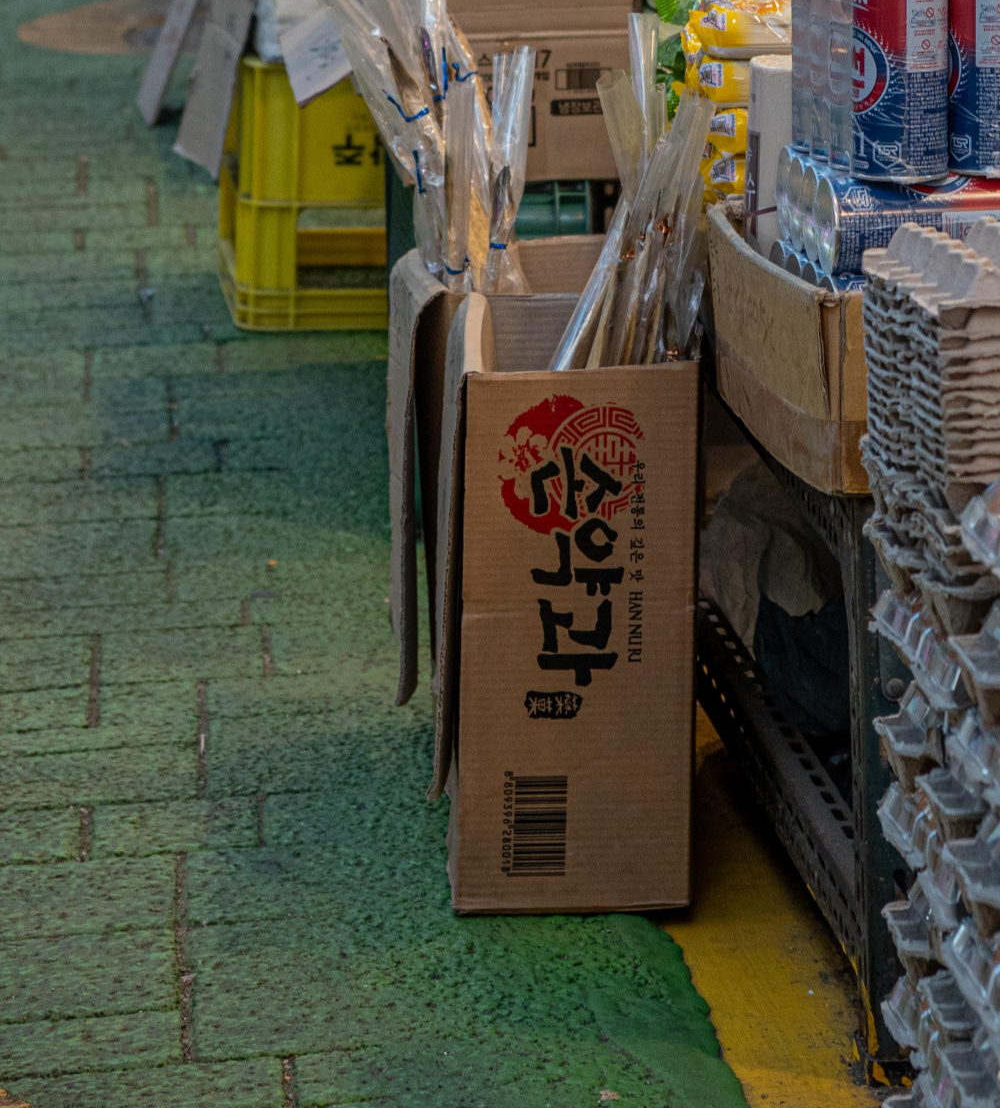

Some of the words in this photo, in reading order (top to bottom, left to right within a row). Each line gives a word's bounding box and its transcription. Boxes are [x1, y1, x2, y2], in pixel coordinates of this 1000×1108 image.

[878, 145, 899, 157] TSR
[631, 459, 646, 486] 우리
[629, 492, 646, 531] 전통의
[530, 446, 625, 687] 손약과
[629, 537, 646, 563] 깊은
[629, 569, 645, 583] 맛
[501, 781, 514, 826] 809396
[500, 829, 513, 874] 280018
